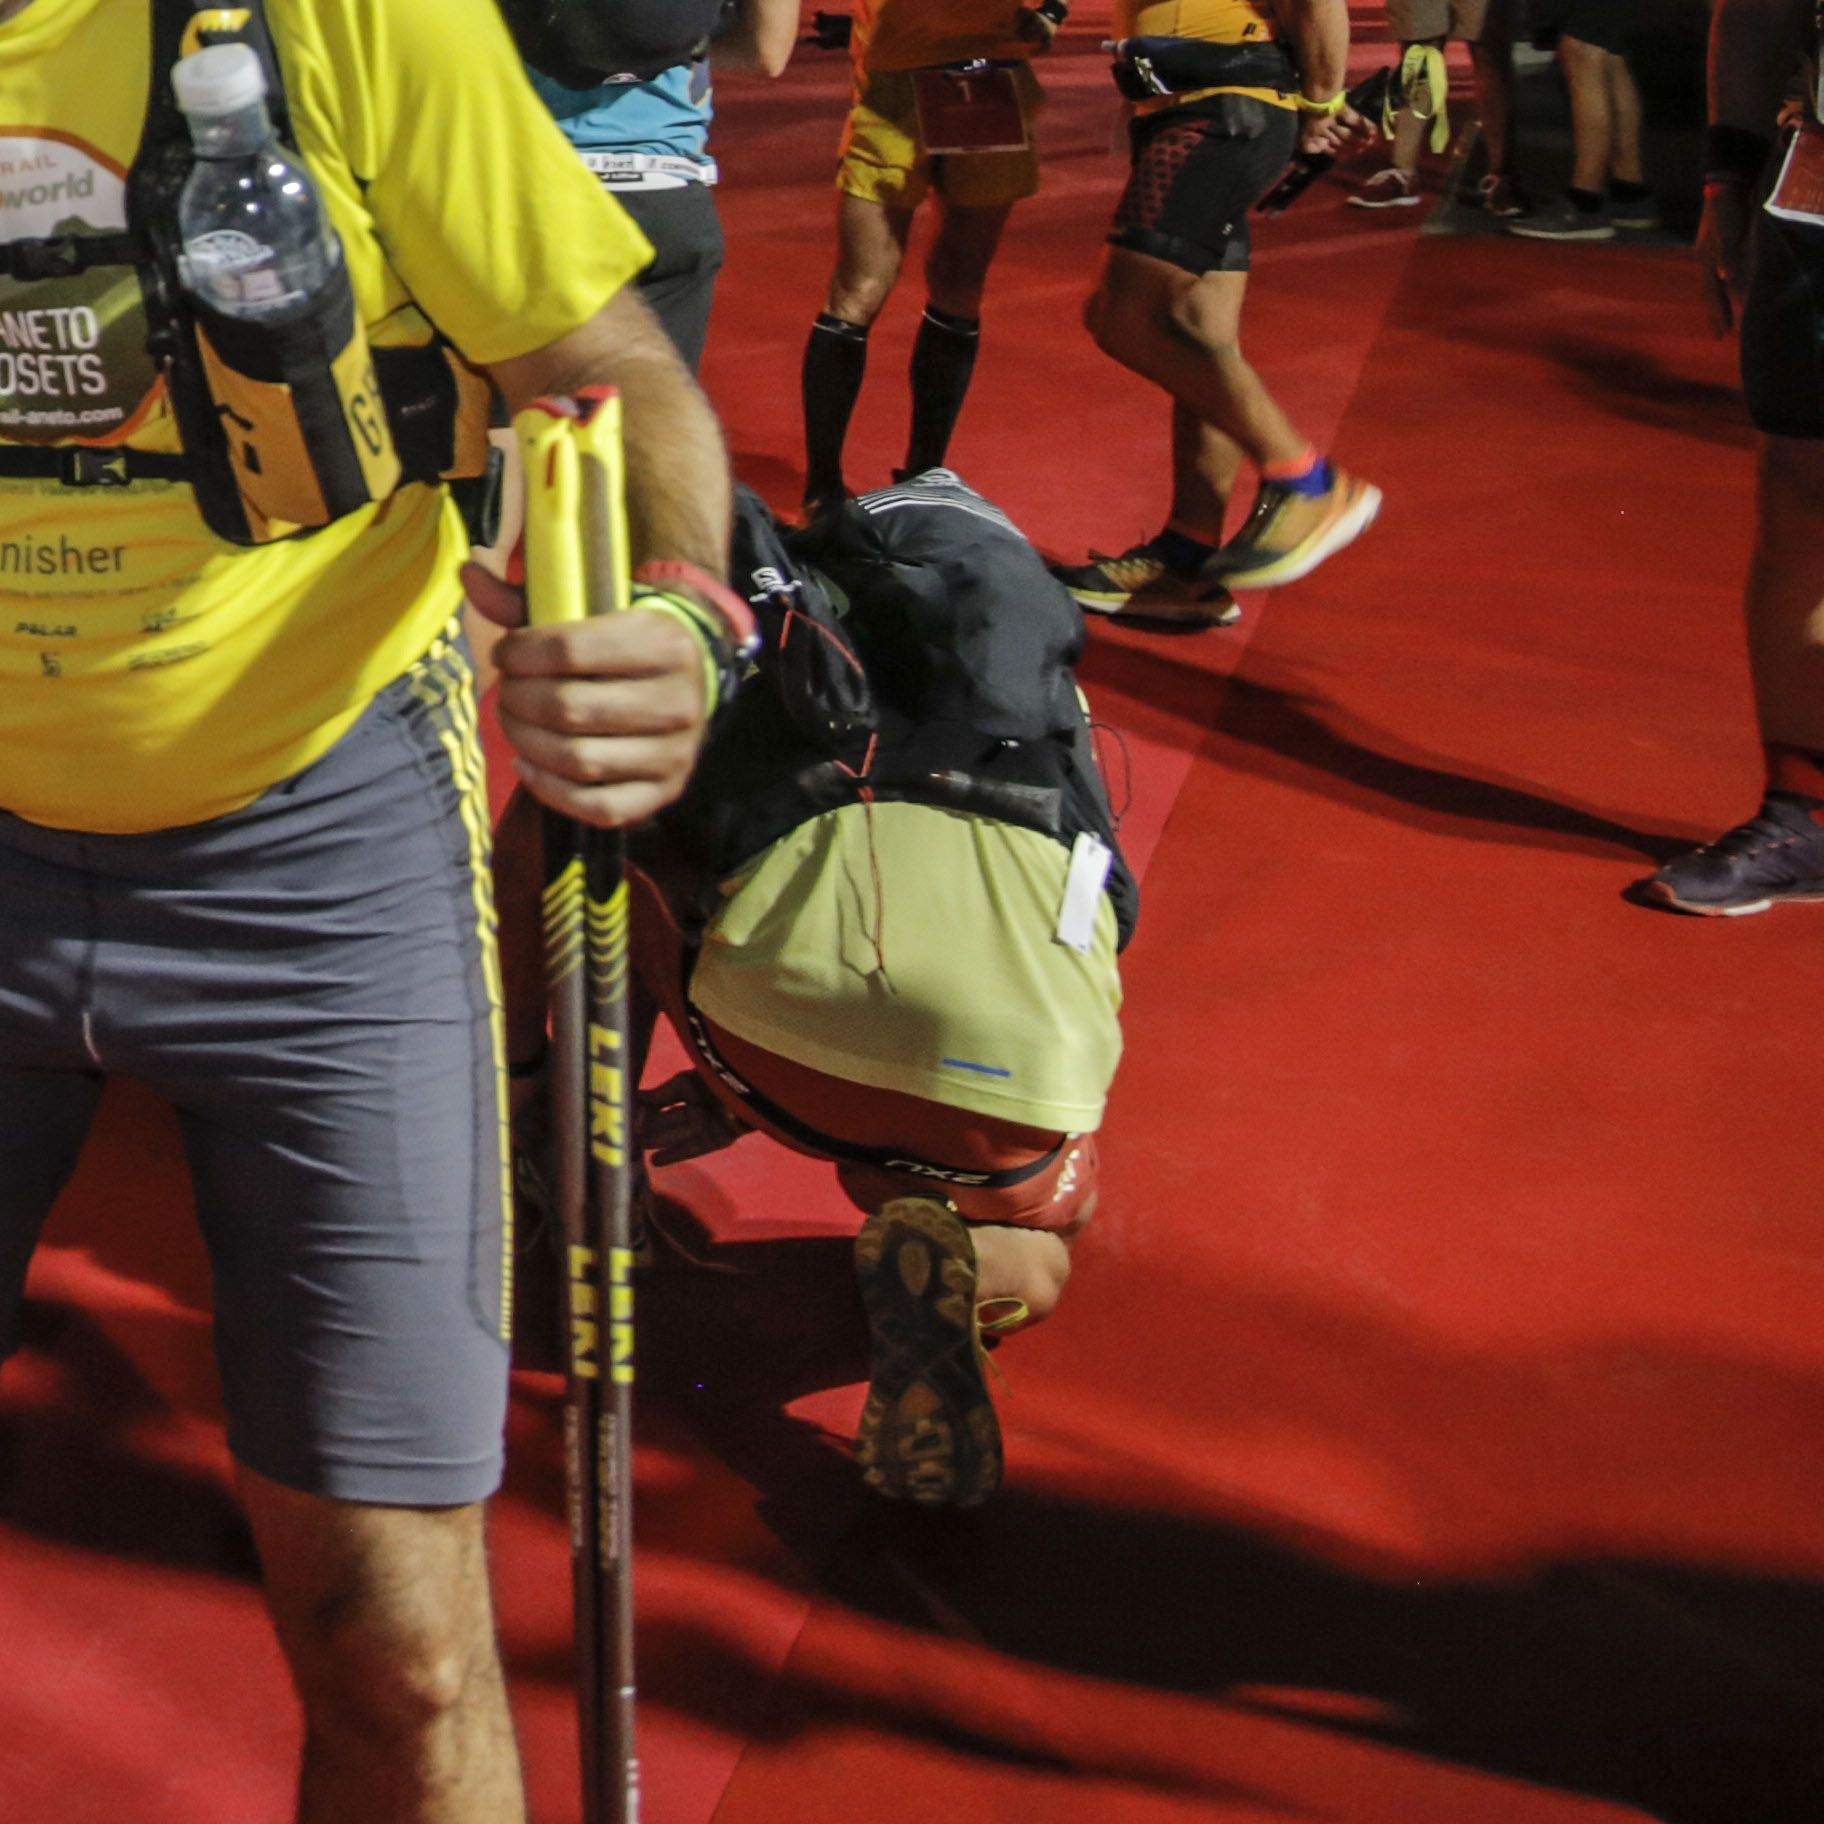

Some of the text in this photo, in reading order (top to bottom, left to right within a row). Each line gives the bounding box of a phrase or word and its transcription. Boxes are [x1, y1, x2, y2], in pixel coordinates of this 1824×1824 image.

[588, 1022, 626, 1168] LEKI
[567, 1243, 601, 1379] LEKI
[609, 1245, 636, 1384] LEKI
